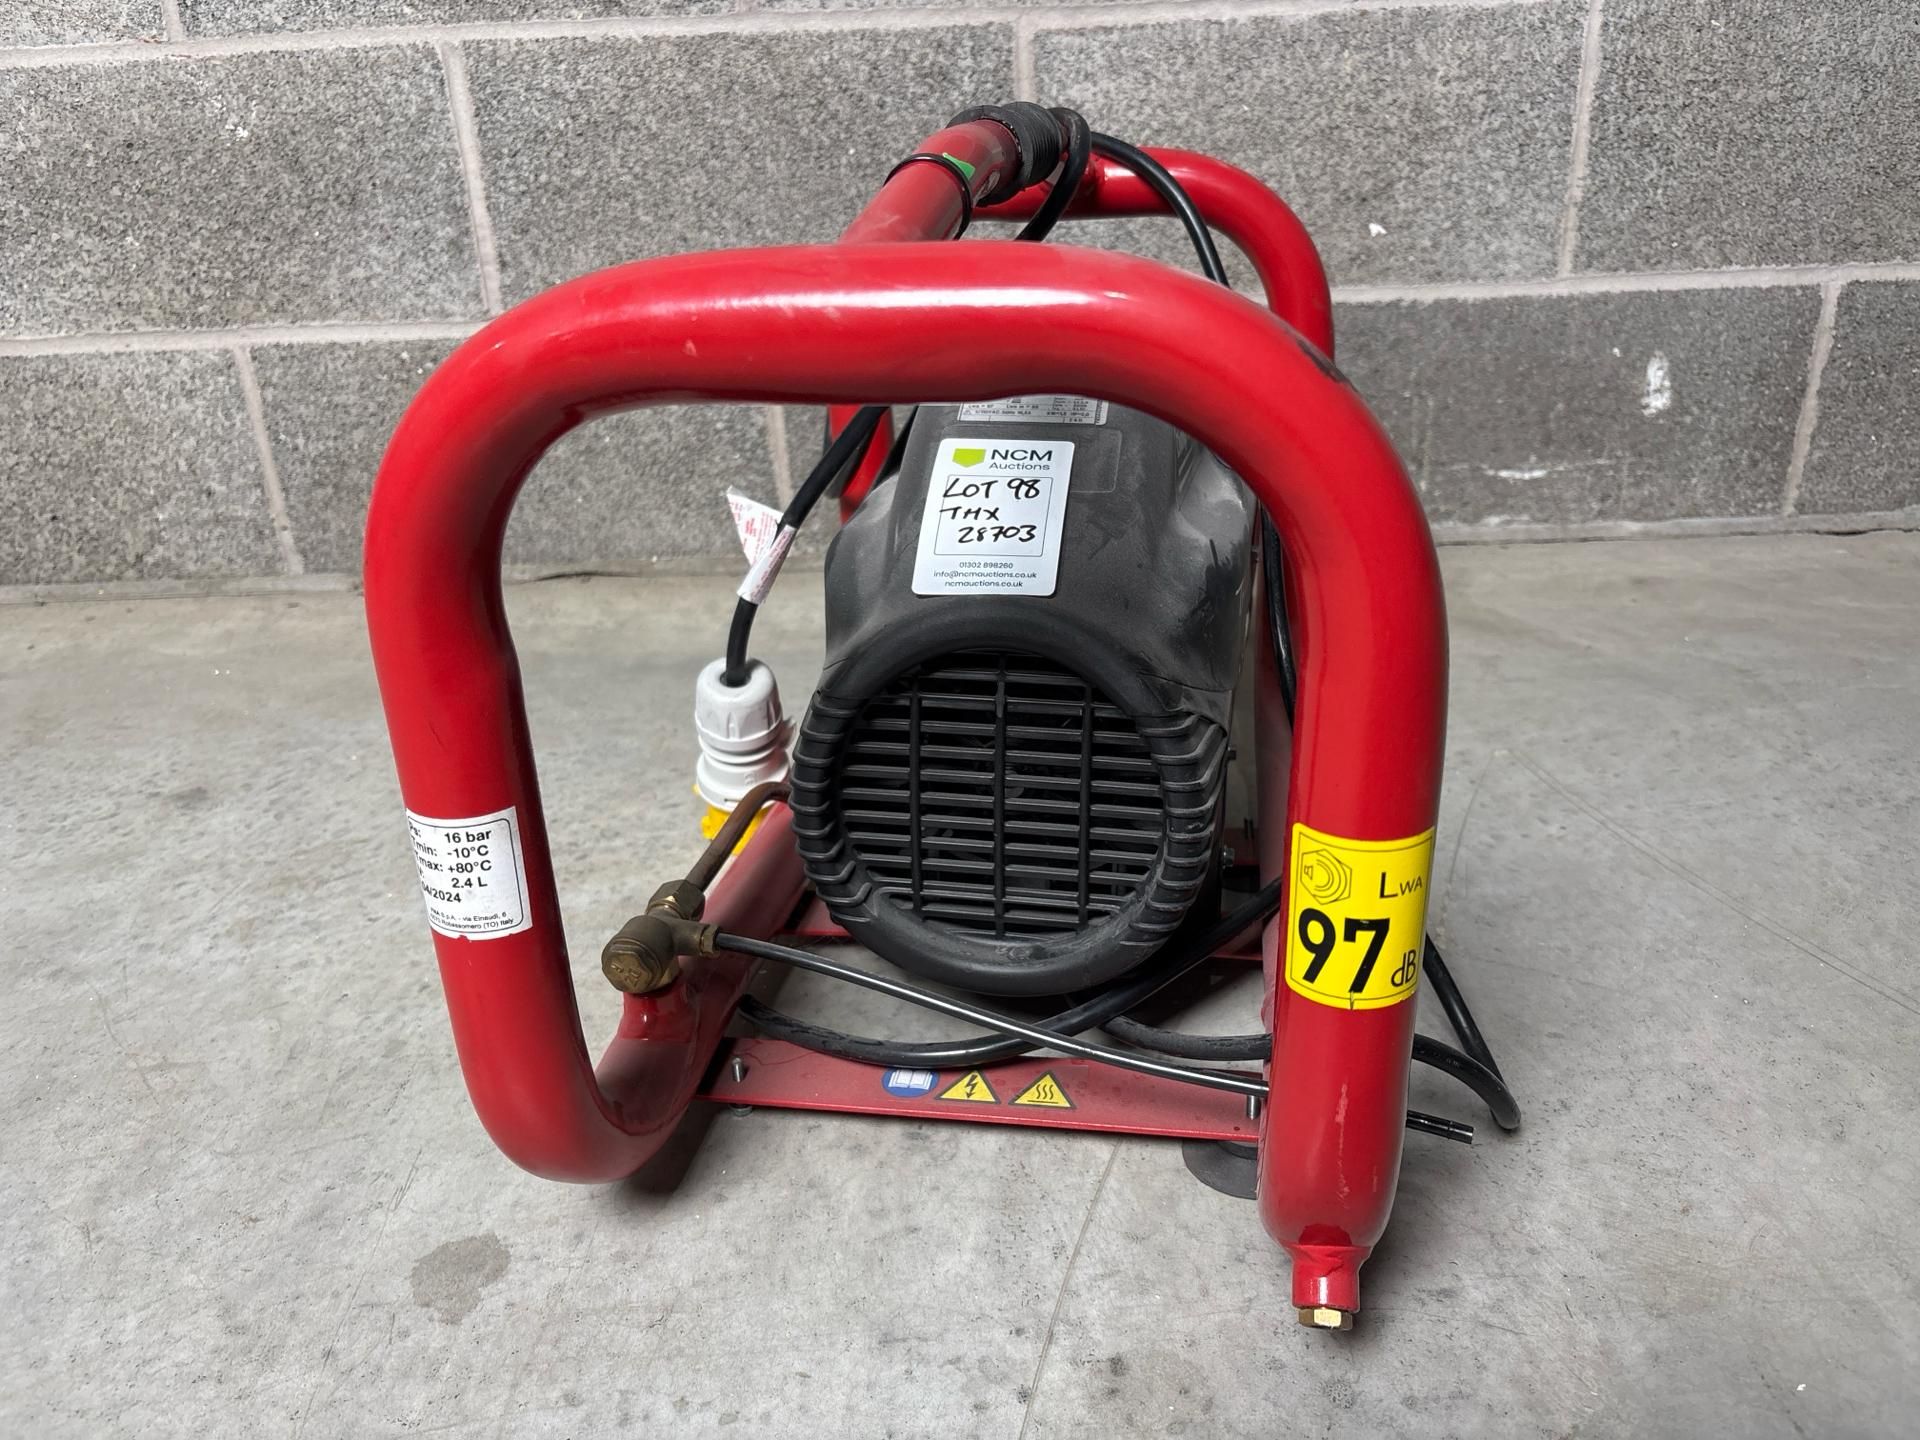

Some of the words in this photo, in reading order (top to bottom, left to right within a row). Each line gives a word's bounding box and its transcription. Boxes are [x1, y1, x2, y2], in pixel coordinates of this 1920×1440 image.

[990, 449, 1053, 462] NCM
[989, 462, 1050, 471] Auctions
[942, 478, 999, 499] LOT
[1007, 478, 1041, 500] 98
[939, 506, 1000, 521] THX
[958, 525, 1037, 543] 28703
[959, 561, 982, 569] 01302
[933, 570, 1037, 579] info@ncmauctions.co.uk
[944, 580, 1024, 588] ncmauctions.co.uk
[444, 832, 462, 844] 16
[466, 829, 492, 843] bar
[416, 841, 438, 857] min:
[447, 844, 490, 859] -10°C
[418, 855, 444, 873] max:
[448, 859, 493, 874] +80°C
[451, 877, 473, 889] 2.4
[478, 876, 488, 888] L
[483, 921, 499, 930] (TO)
[500, 918, 514, 926] Italy
[1298, 907, 1391, 994] 97
[1390, 949, 1417, 988] dB
